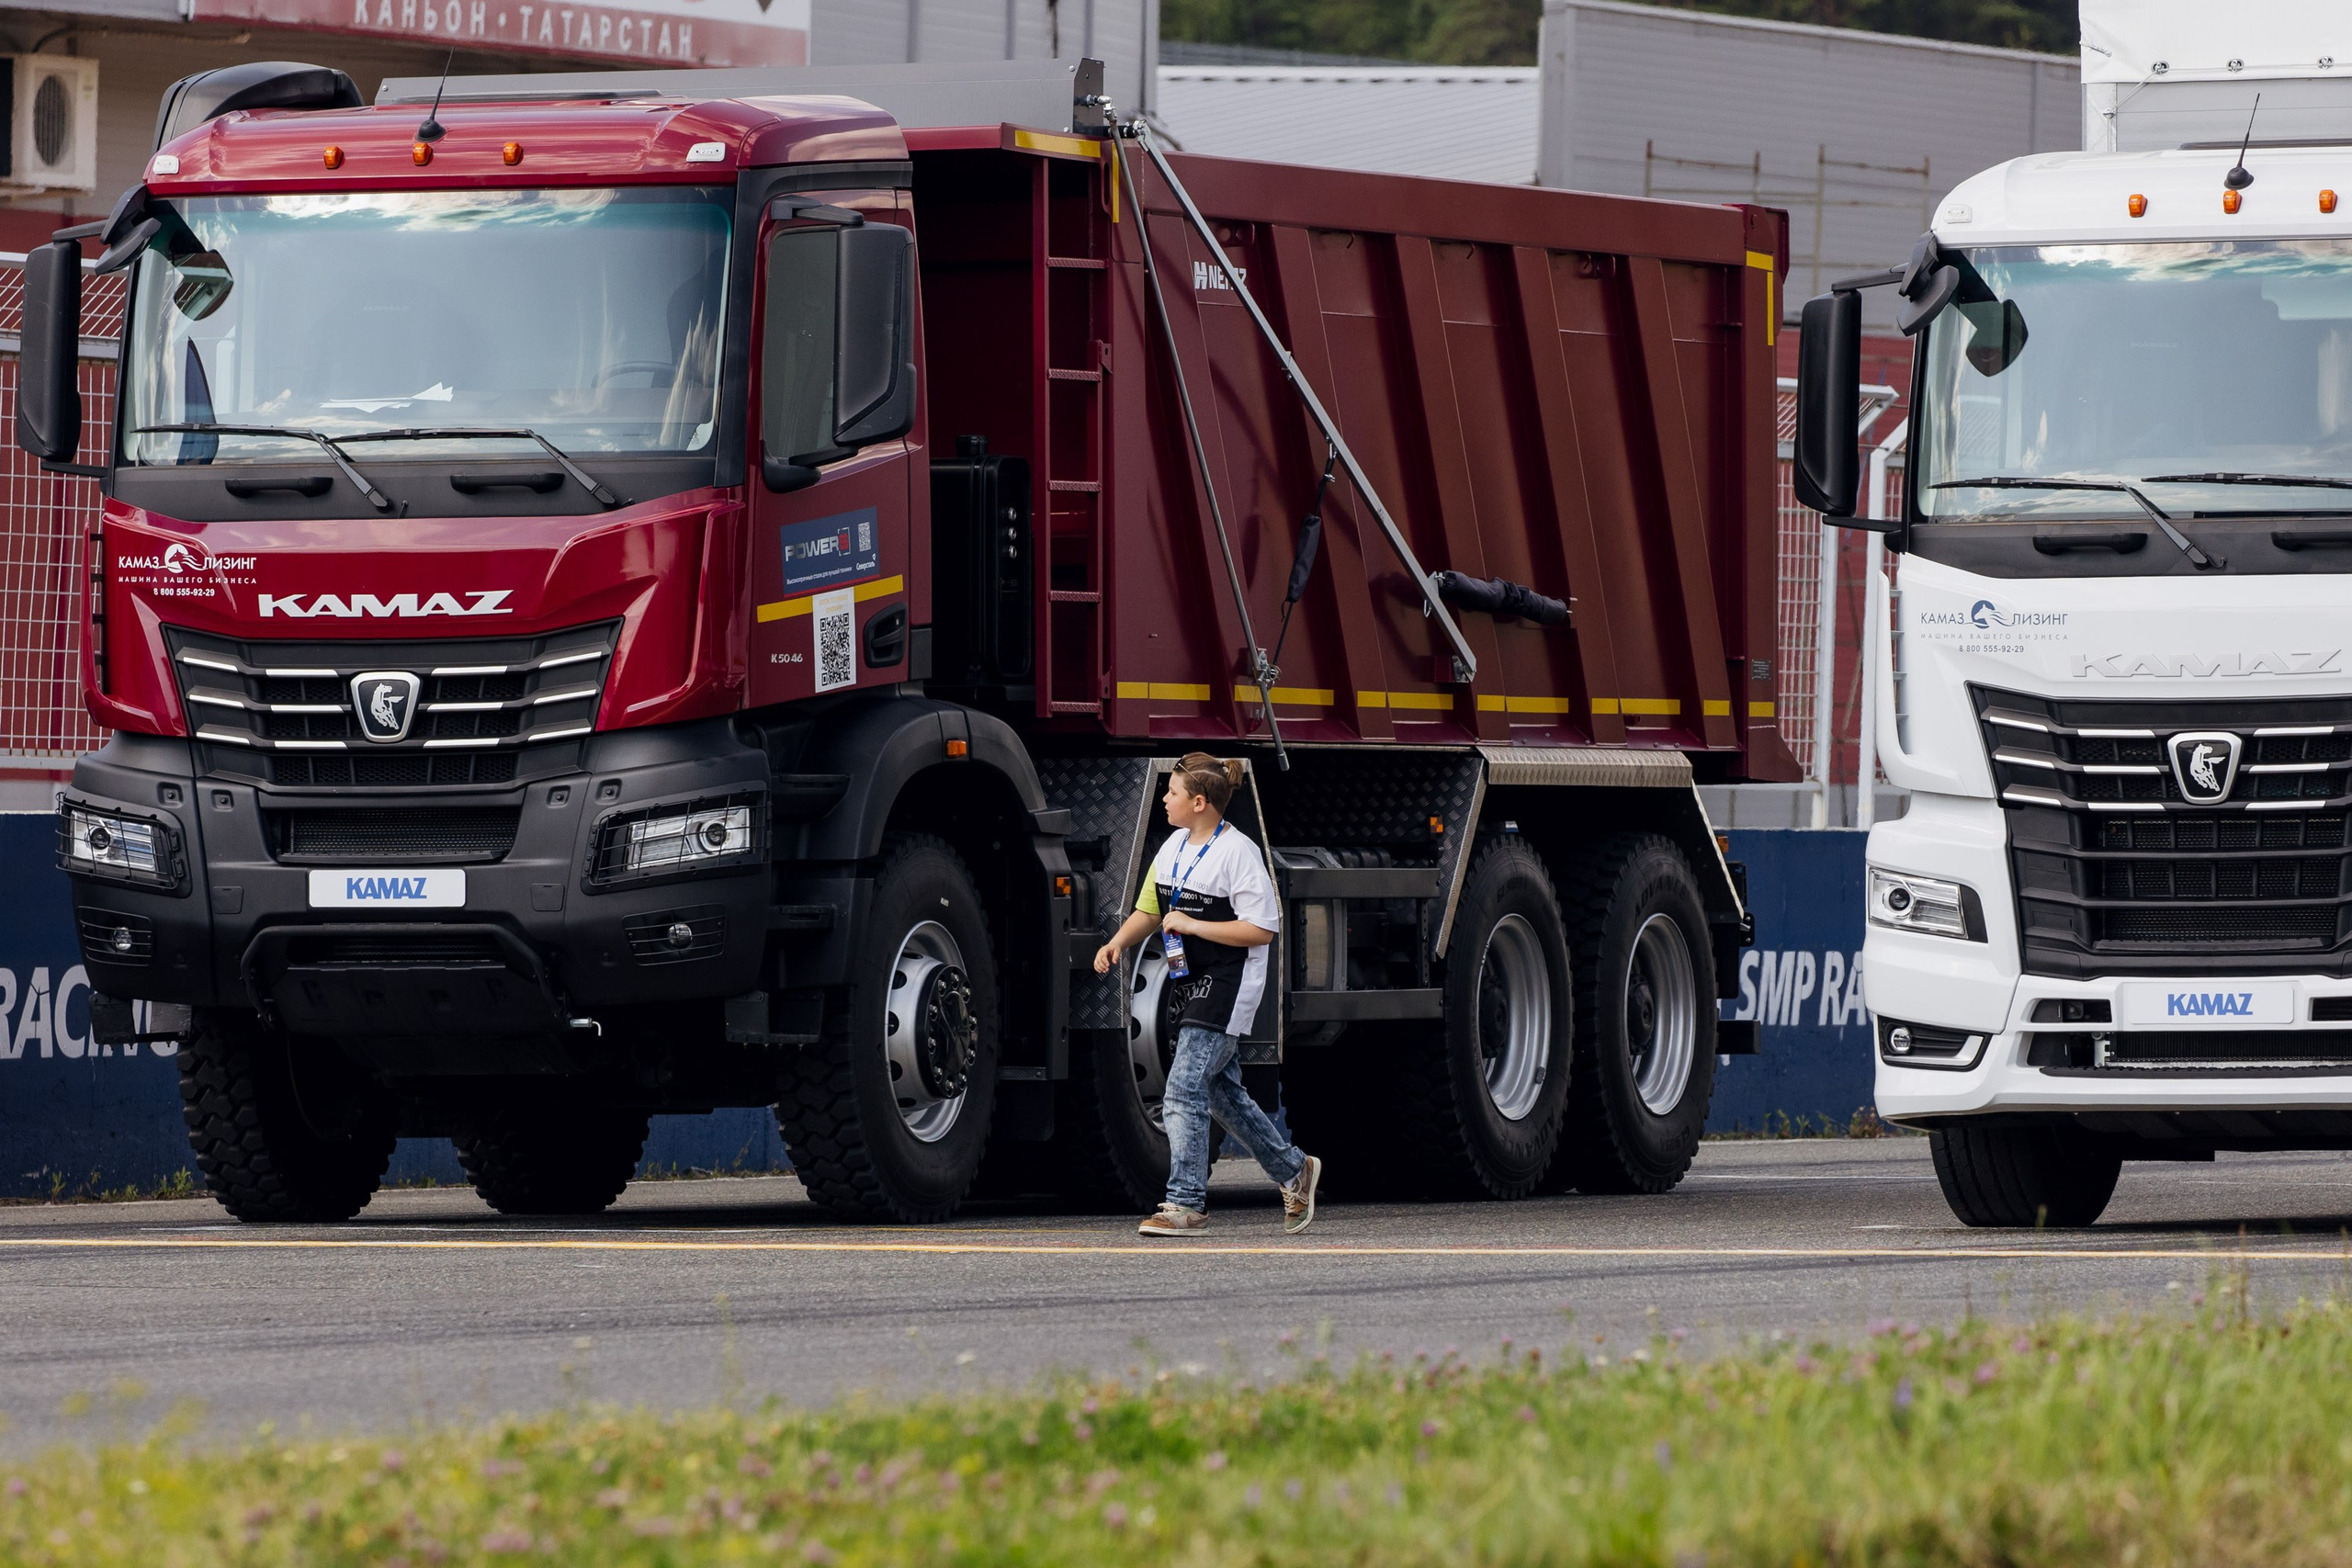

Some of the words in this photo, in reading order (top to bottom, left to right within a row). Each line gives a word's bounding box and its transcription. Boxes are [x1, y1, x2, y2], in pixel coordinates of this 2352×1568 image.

[355, 0, 486, 37] КАНЬОН
[518, 4, 694, 58] ТАТАРСТАН
[1208, 265, 1248, 291] NEZ
[119, 556, 160, 569] КАМАЗ
[203, 557, 257, 570] ЛИЗИНГ
[164, 576, 203, 584] ВАШЕГО
[160, 588, 175, 596] 800
[176, 589, 215, 597] 555-92-29
[258, 590, 514, 618] KAMAZ
[1921, 613, 1964, 625] КАМАЗ
[2012, 613, 2068, 626] ЛИЗИНГ
[1984, 645, 2024, 653] 555-92-29
[2070, 649, 2342, 678] KAMAZ
[346, 877, 427, 899] KAMAZ
[1735, 949, 1816, 1026] SMP
[1818, 951, 1873, 1026] RA
[2167, 993, 2254, 1016] KAMAZ
